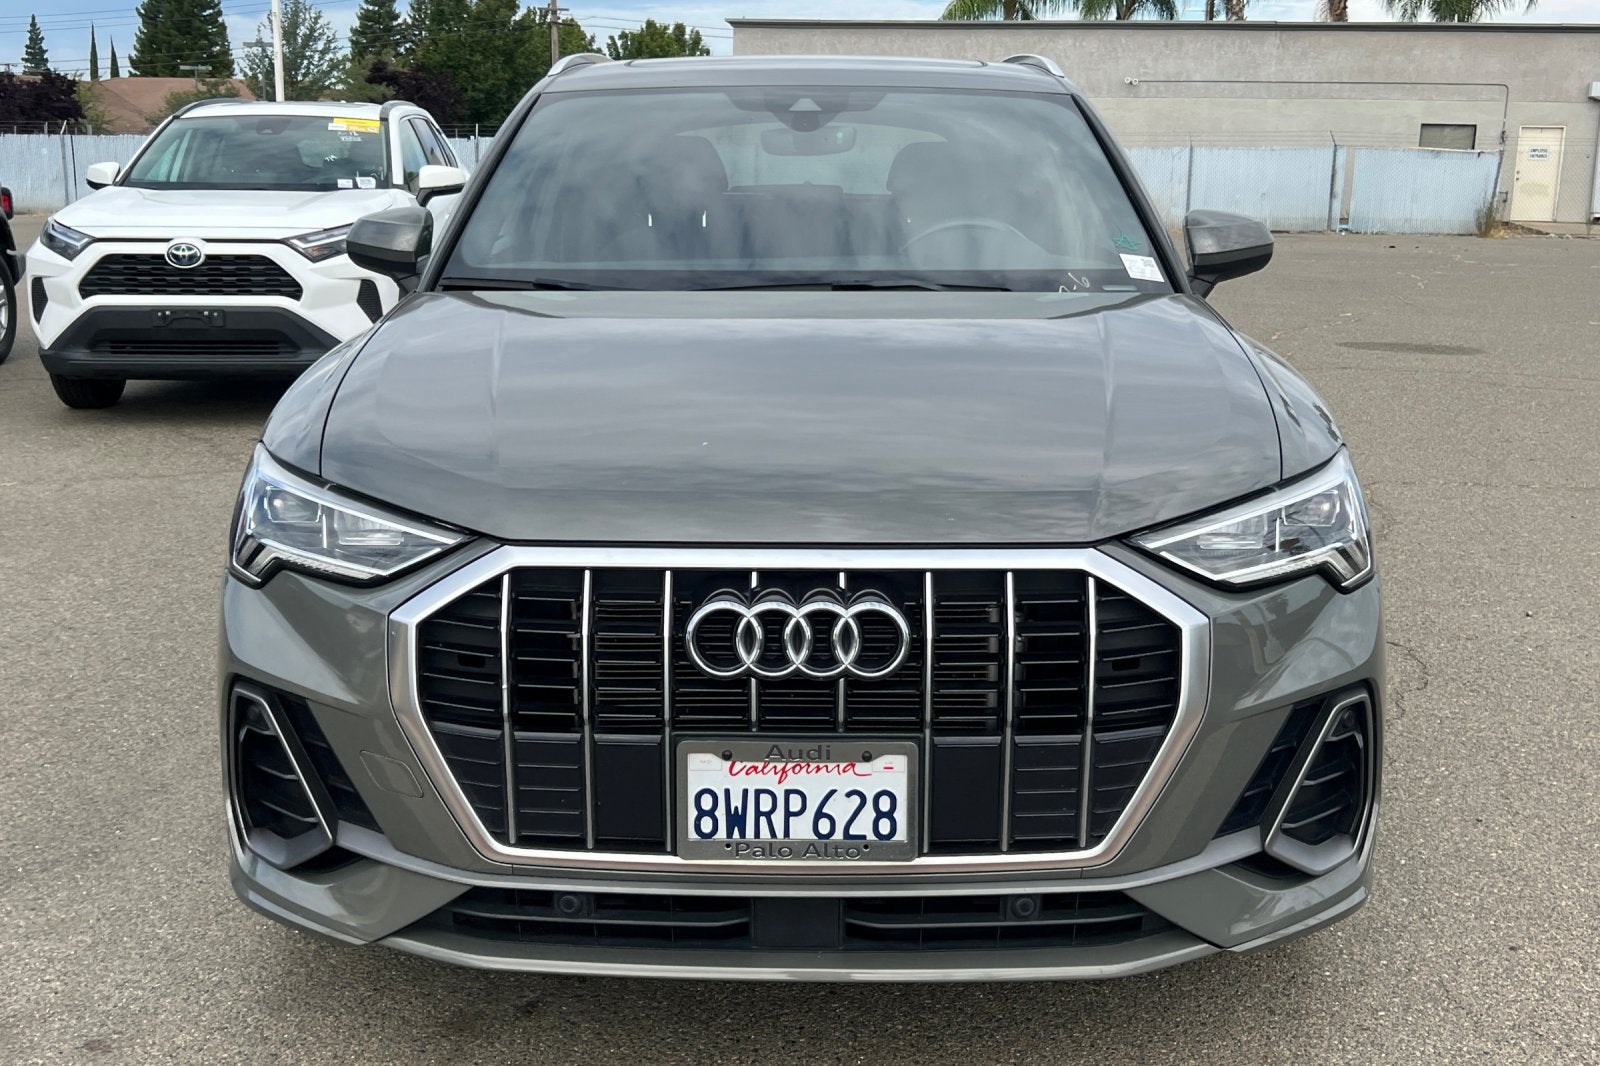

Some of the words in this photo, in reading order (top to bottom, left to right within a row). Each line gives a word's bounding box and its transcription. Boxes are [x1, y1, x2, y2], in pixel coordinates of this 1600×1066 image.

[765, 744, 831, 761] Audi
[728, 760, 872, 784] California
[693, 787, 898, 841] 8WRP628
[734, 843, 793, 859] Palo
[802, 843, 861, 859] Alto
